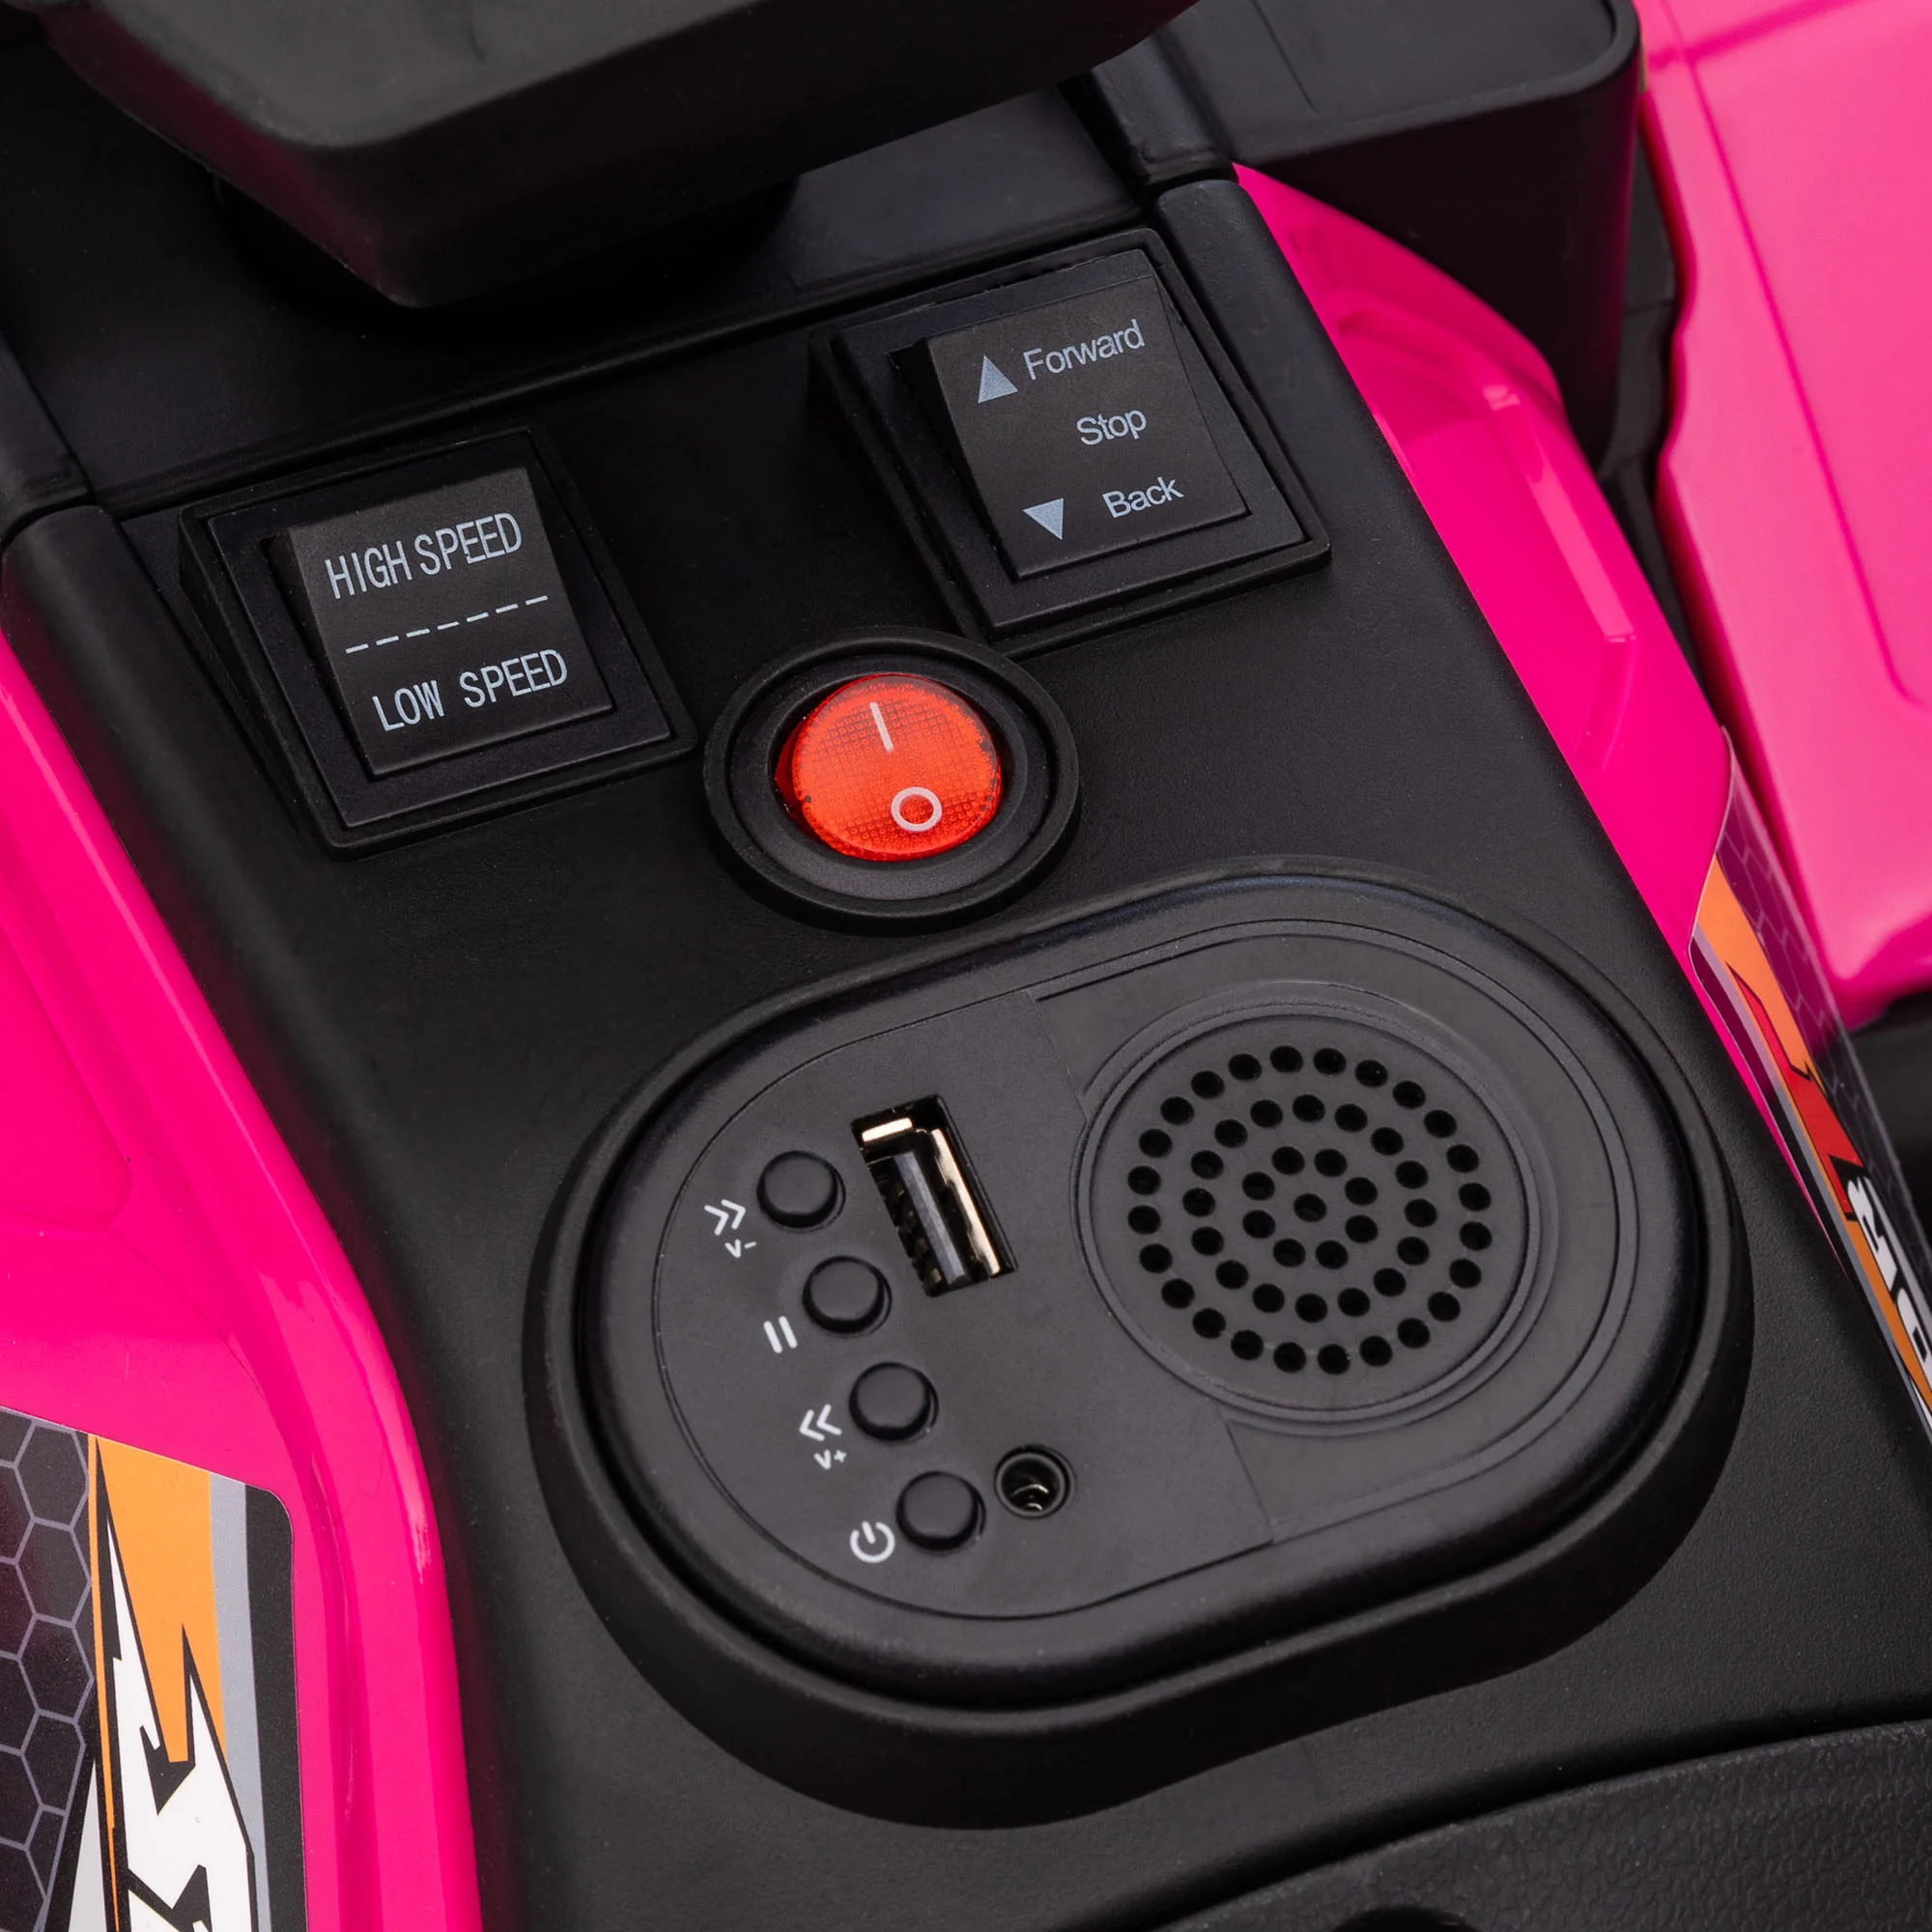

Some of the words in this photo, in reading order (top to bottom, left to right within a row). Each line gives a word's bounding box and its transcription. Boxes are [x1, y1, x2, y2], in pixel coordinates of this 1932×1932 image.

[1023, 319, 1146, 381] Forward
[1076, 409, 1147, 445] Stop
[1102, 476, 1184, 519] Back
[325, 540, 413, 600] HIGH
[413, 512, 523, 576] SPEED
[372, 680, 445, 731] LOW
[459, 649, 568, 709] SPEED
